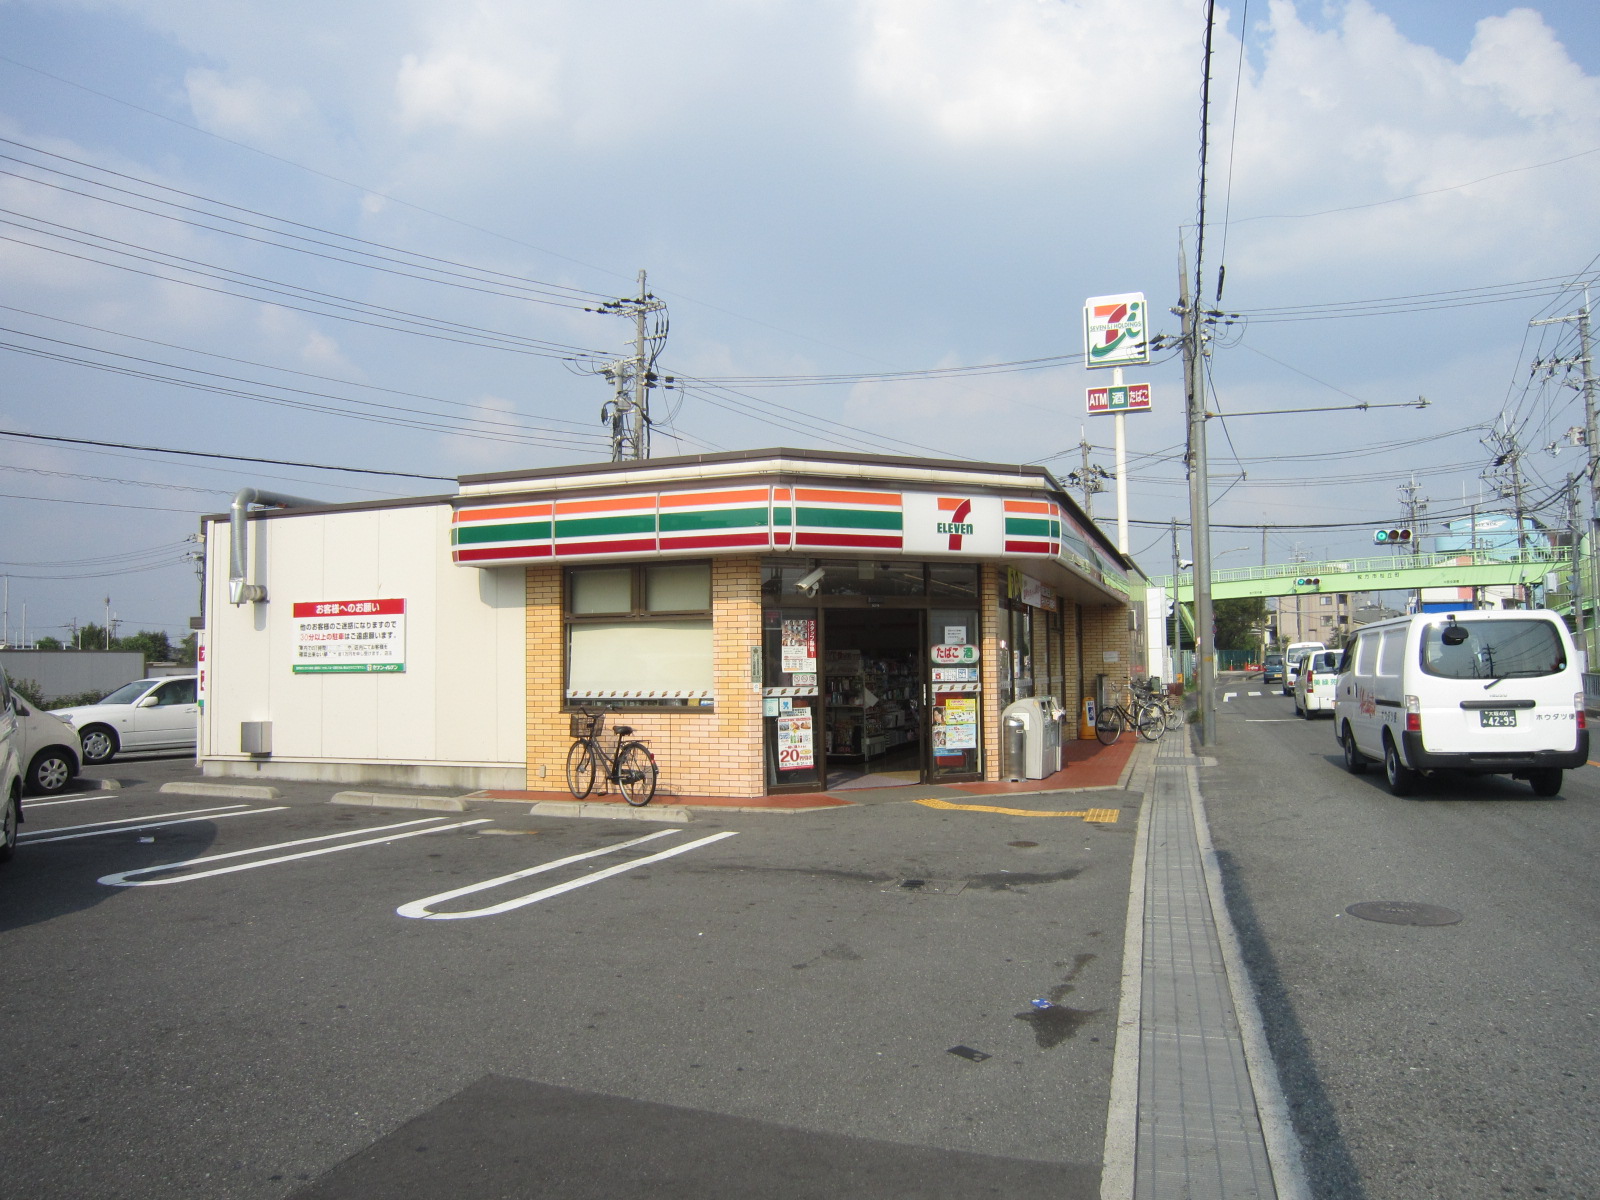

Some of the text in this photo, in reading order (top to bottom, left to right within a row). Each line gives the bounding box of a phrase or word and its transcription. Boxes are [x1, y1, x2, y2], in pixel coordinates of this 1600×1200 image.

[1113, 321, 1142, 330] HOLDINGS
[1089, 393, 1107, 406] ATM
[1112, 392, 1124, 405] 酒
[1129, 390, 1148, 402] たばこ
[937, 498, 971, 550] 7
[316, 602, 380, 614] お客様へのお願い
[300, 620, 397, 631] 他のお客様のご迷惑になりますので
[936, 646, 974, 658] たばこ 酒
[1488, 716, 1515, 726] 42-95
[780, 749, 800, 763] 20
